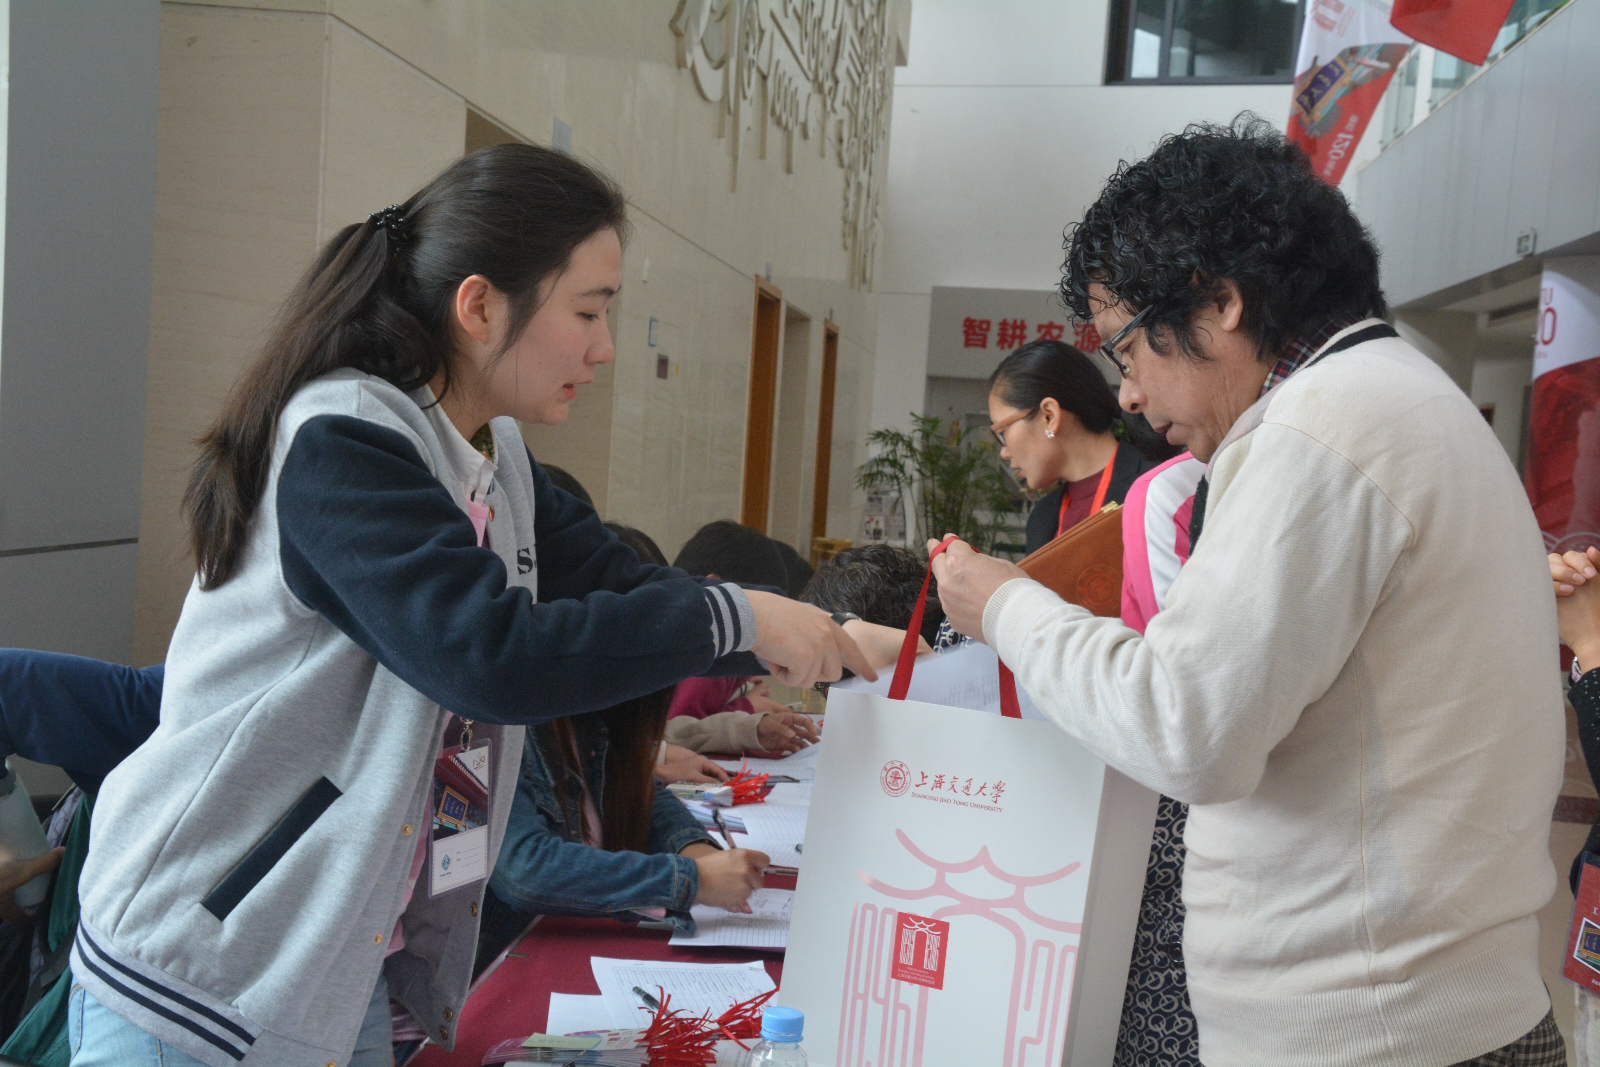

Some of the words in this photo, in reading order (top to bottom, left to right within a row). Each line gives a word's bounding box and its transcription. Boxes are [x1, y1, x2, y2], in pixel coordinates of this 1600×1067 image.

[963, 317, 1101, 353] 智耕农源
[516, 546, 537, 575] S
[911, 791, 939, 803] SHANGHAI
[953, 798, 968, 807] TONG
[970, 802, 1002, 812] UNIVERSITY
